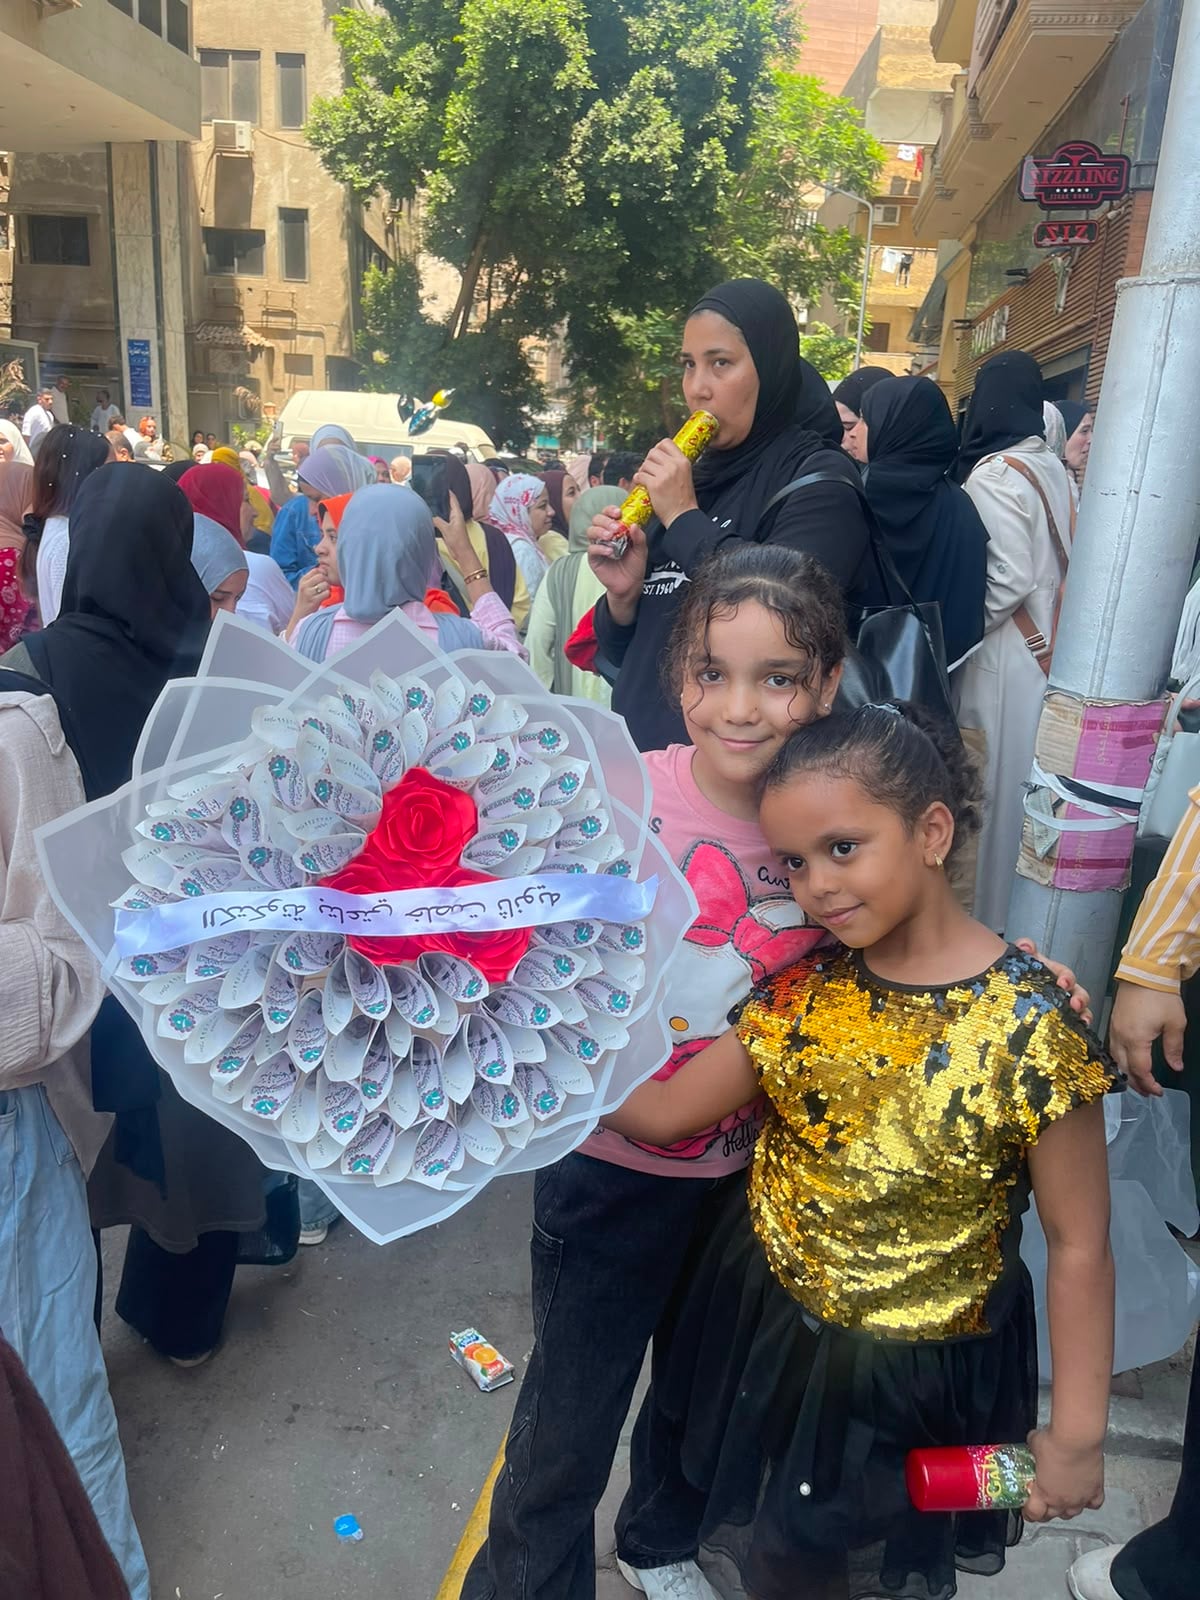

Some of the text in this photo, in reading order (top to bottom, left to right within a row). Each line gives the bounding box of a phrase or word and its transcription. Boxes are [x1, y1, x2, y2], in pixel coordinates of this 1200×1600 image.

[1029, 168, 1119, 184] SIZZLING
[642, 581, 674, 596] ST. 1960
[203, 899, 306, 929] الكتكوتة
[319, 898, 393, 925] بتاعتي
[405, 901, 486, 924] خلصت
